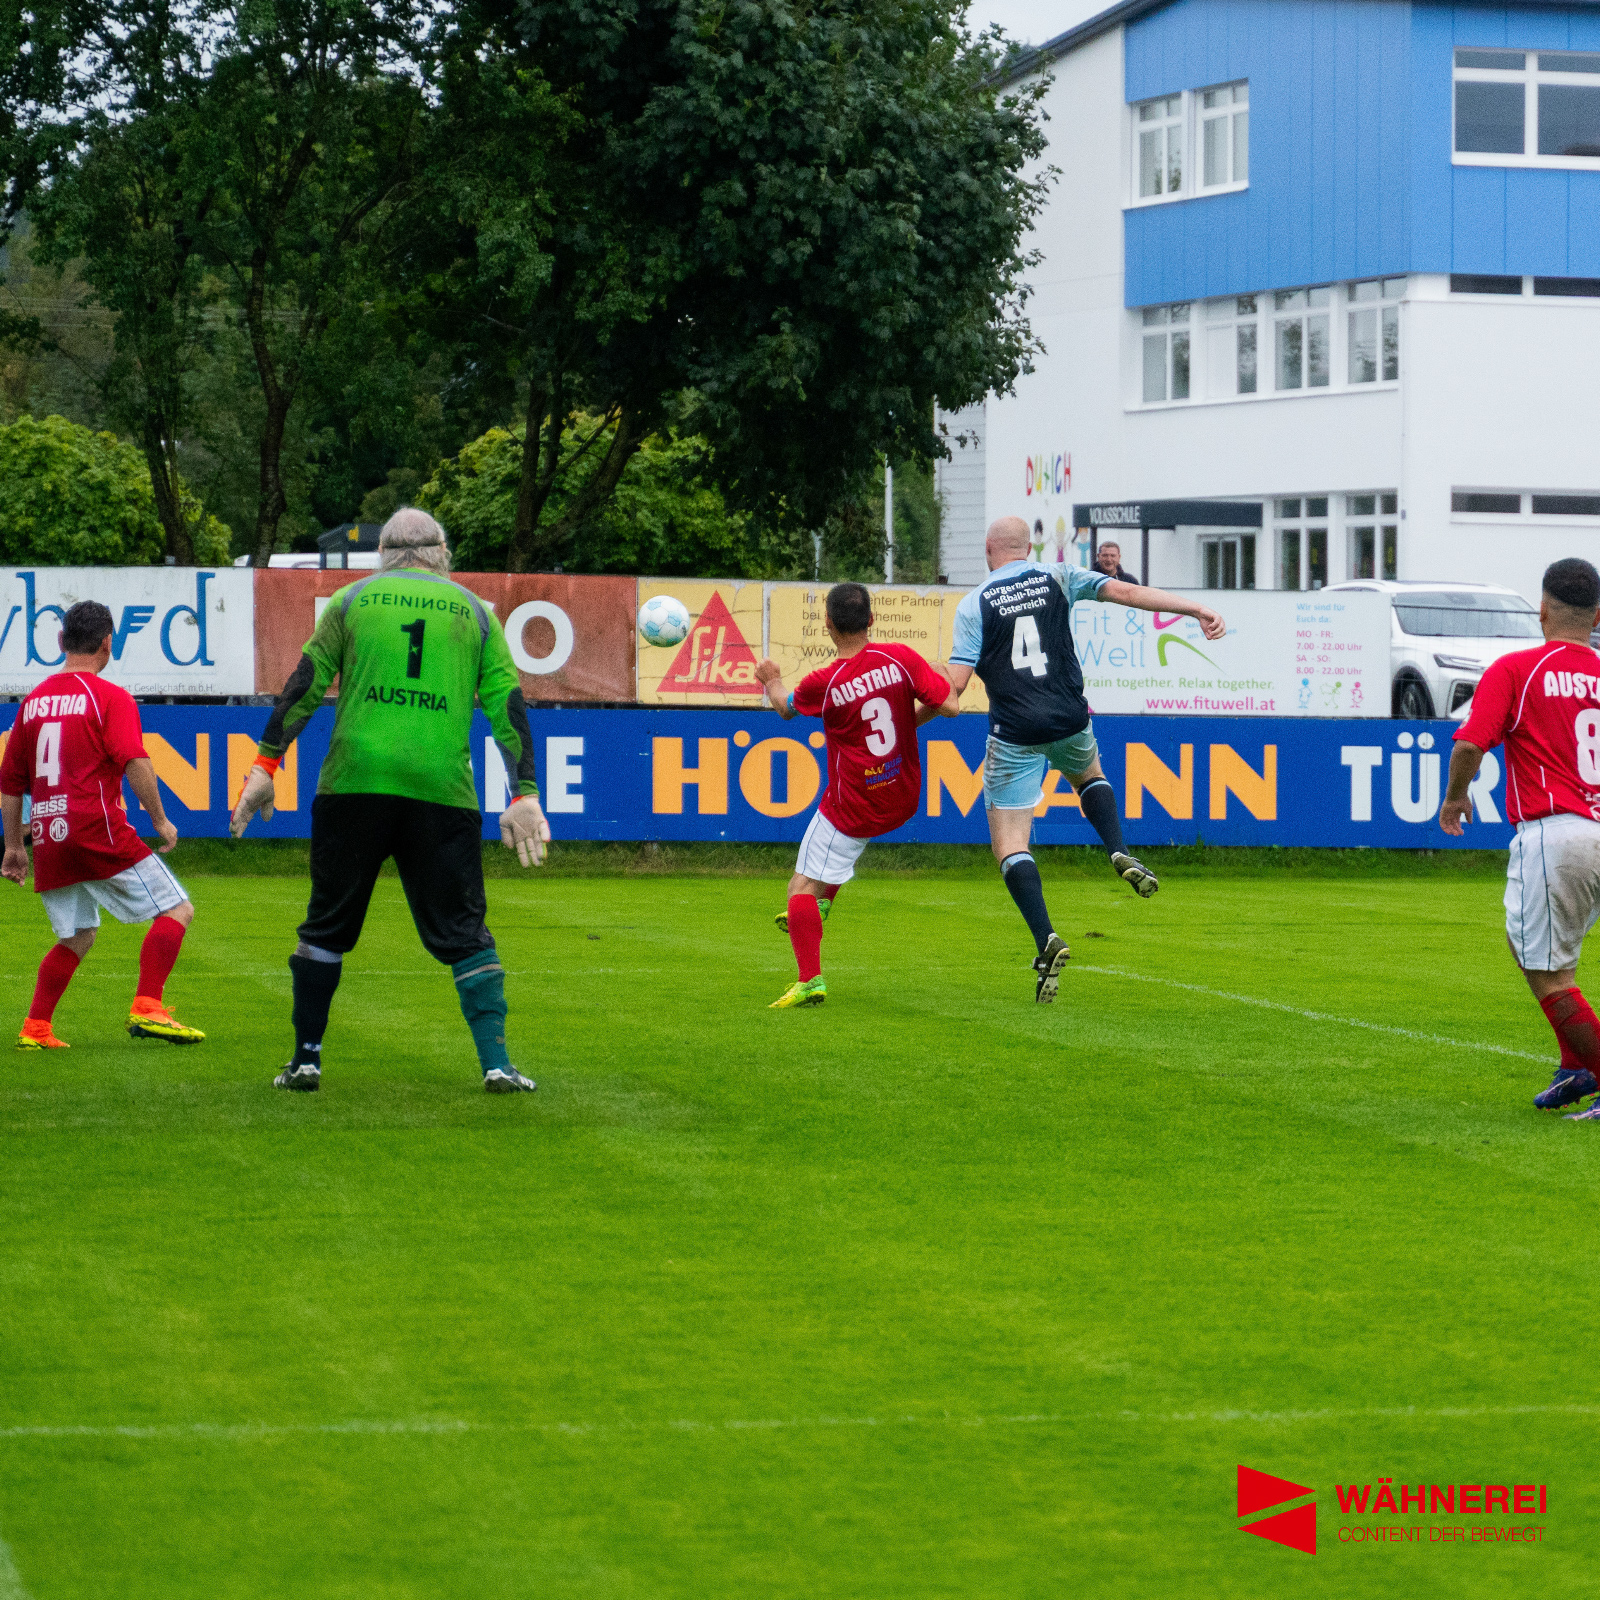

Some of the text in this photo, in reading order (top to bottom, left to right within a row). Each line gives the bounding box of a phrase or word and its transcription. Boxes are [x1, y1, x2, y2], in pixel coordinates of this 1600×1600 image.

[1089, 505, 1140, 524] VOLKSSCHULE
[983, 574, 1048, 600] Bürgermeister
[990, 586, 1050, 608] Fußball-Team
[360, 593, 471, 619] STEININGER
[802, 593, 818, 605] Ihr
[901, 595, 945, 608] Partner
[999, 597, 1047, 616] Österreich
[802, 610, 820, 621] bei
[1074, 608, 1145, 635] Fit &
[802, 626, 818, 638] für
[876, 628, 928, 640] Industrie
[1296, 630, 1312, 638] MO
[1320, 630, 1334, 638] FR:
[401, 618, 425, 679] 1
[1011, 615, 1049, 677] 4
[1075, 639, 1145, 667] Well
[1296, 642, 1315, 650] 7.00
[1322, 642, 1345, 651] 22.00
[1347, 643, 1363, 651] Uhr
[1296, 654, 1307, 662] SA
[1296, 666, 1315, 674] 8.00
[1322, 667, 1345, 675] 22.00
[1347, 667, 1363, 675] Uhr
[134, 683, 186, 693] Gesellschaft
[831, 663, 902, 707] AUSTRIA
[1082, 676, 1275, 692] Train together. Relax together.
[1544, 671, 1600, 700] AUST
[23, 694, 87, 724] AUSTRIA
[365, 686, 448, 714] AUSTRIA
[1146, 696, 1276, 711] www.fituwell.at
[861, 697, 897, 757] 3
[35, 722, 62, 786] 4
[1575, 708, 1600, 785] 8
